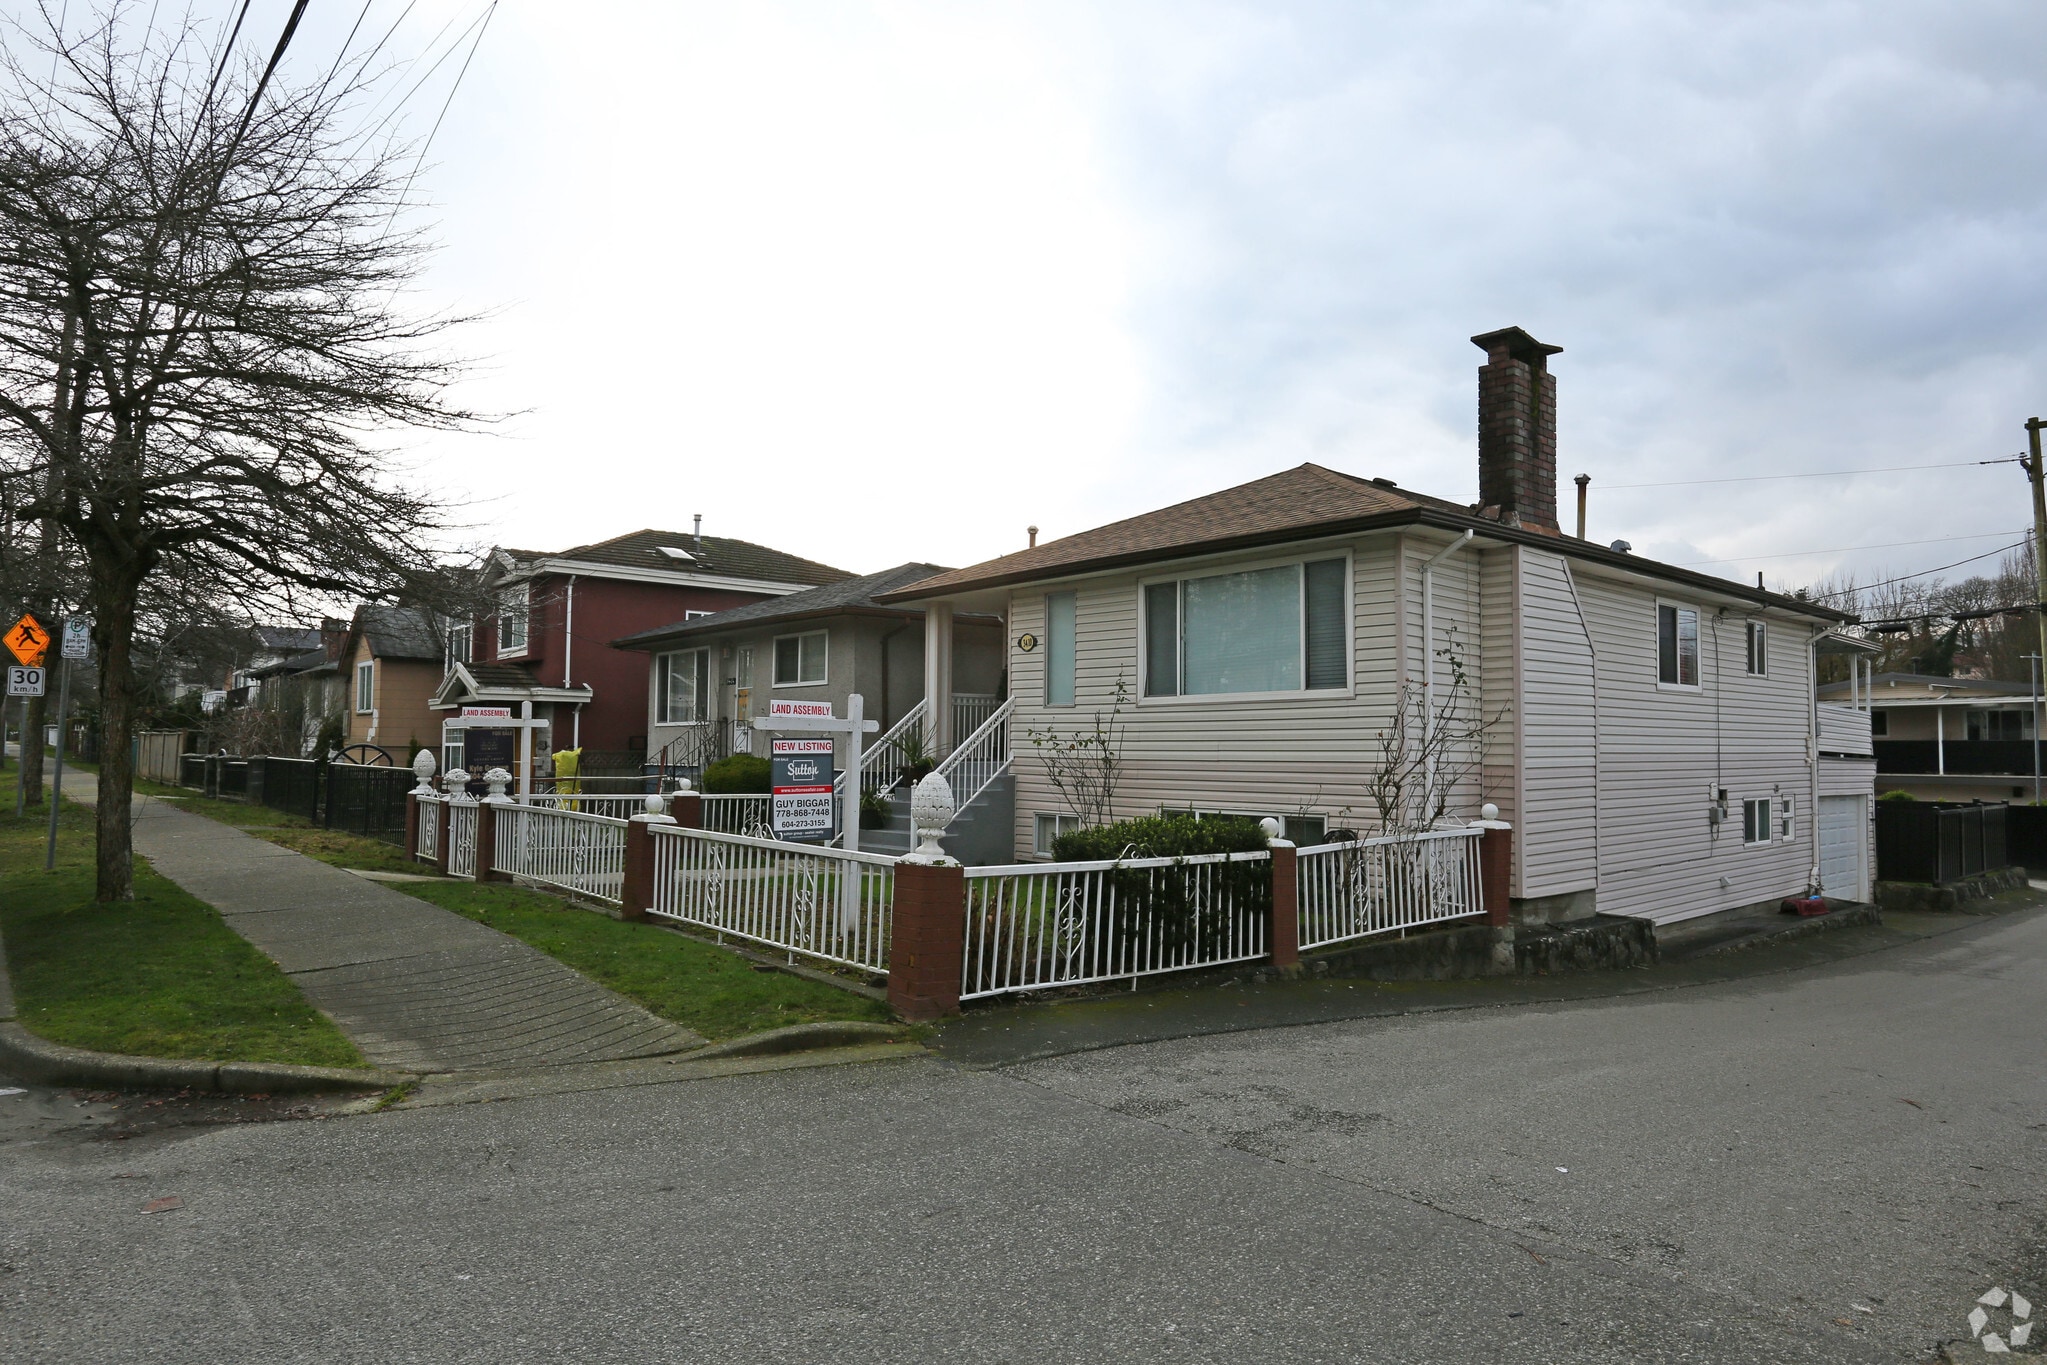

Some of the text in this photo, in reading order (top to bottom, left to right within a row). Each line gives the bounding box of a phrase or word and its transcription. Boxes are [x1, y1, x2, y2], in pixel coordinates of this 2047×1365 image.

[14, 670, 40, 684] 30
[480, 709, 510, 717] ASSEMBLY
[771, 704, 830, 716] LAND ASSEMBLY
[774, 742, 832, 751] NEW LISTING
[787, 762, 819, 776] Sutton
[776, 799, 830, 808] GUY BIGGAR
[776, 808, 830, 818] 778-868-7448
[781, 820, 826, 828] 604-273-3155
